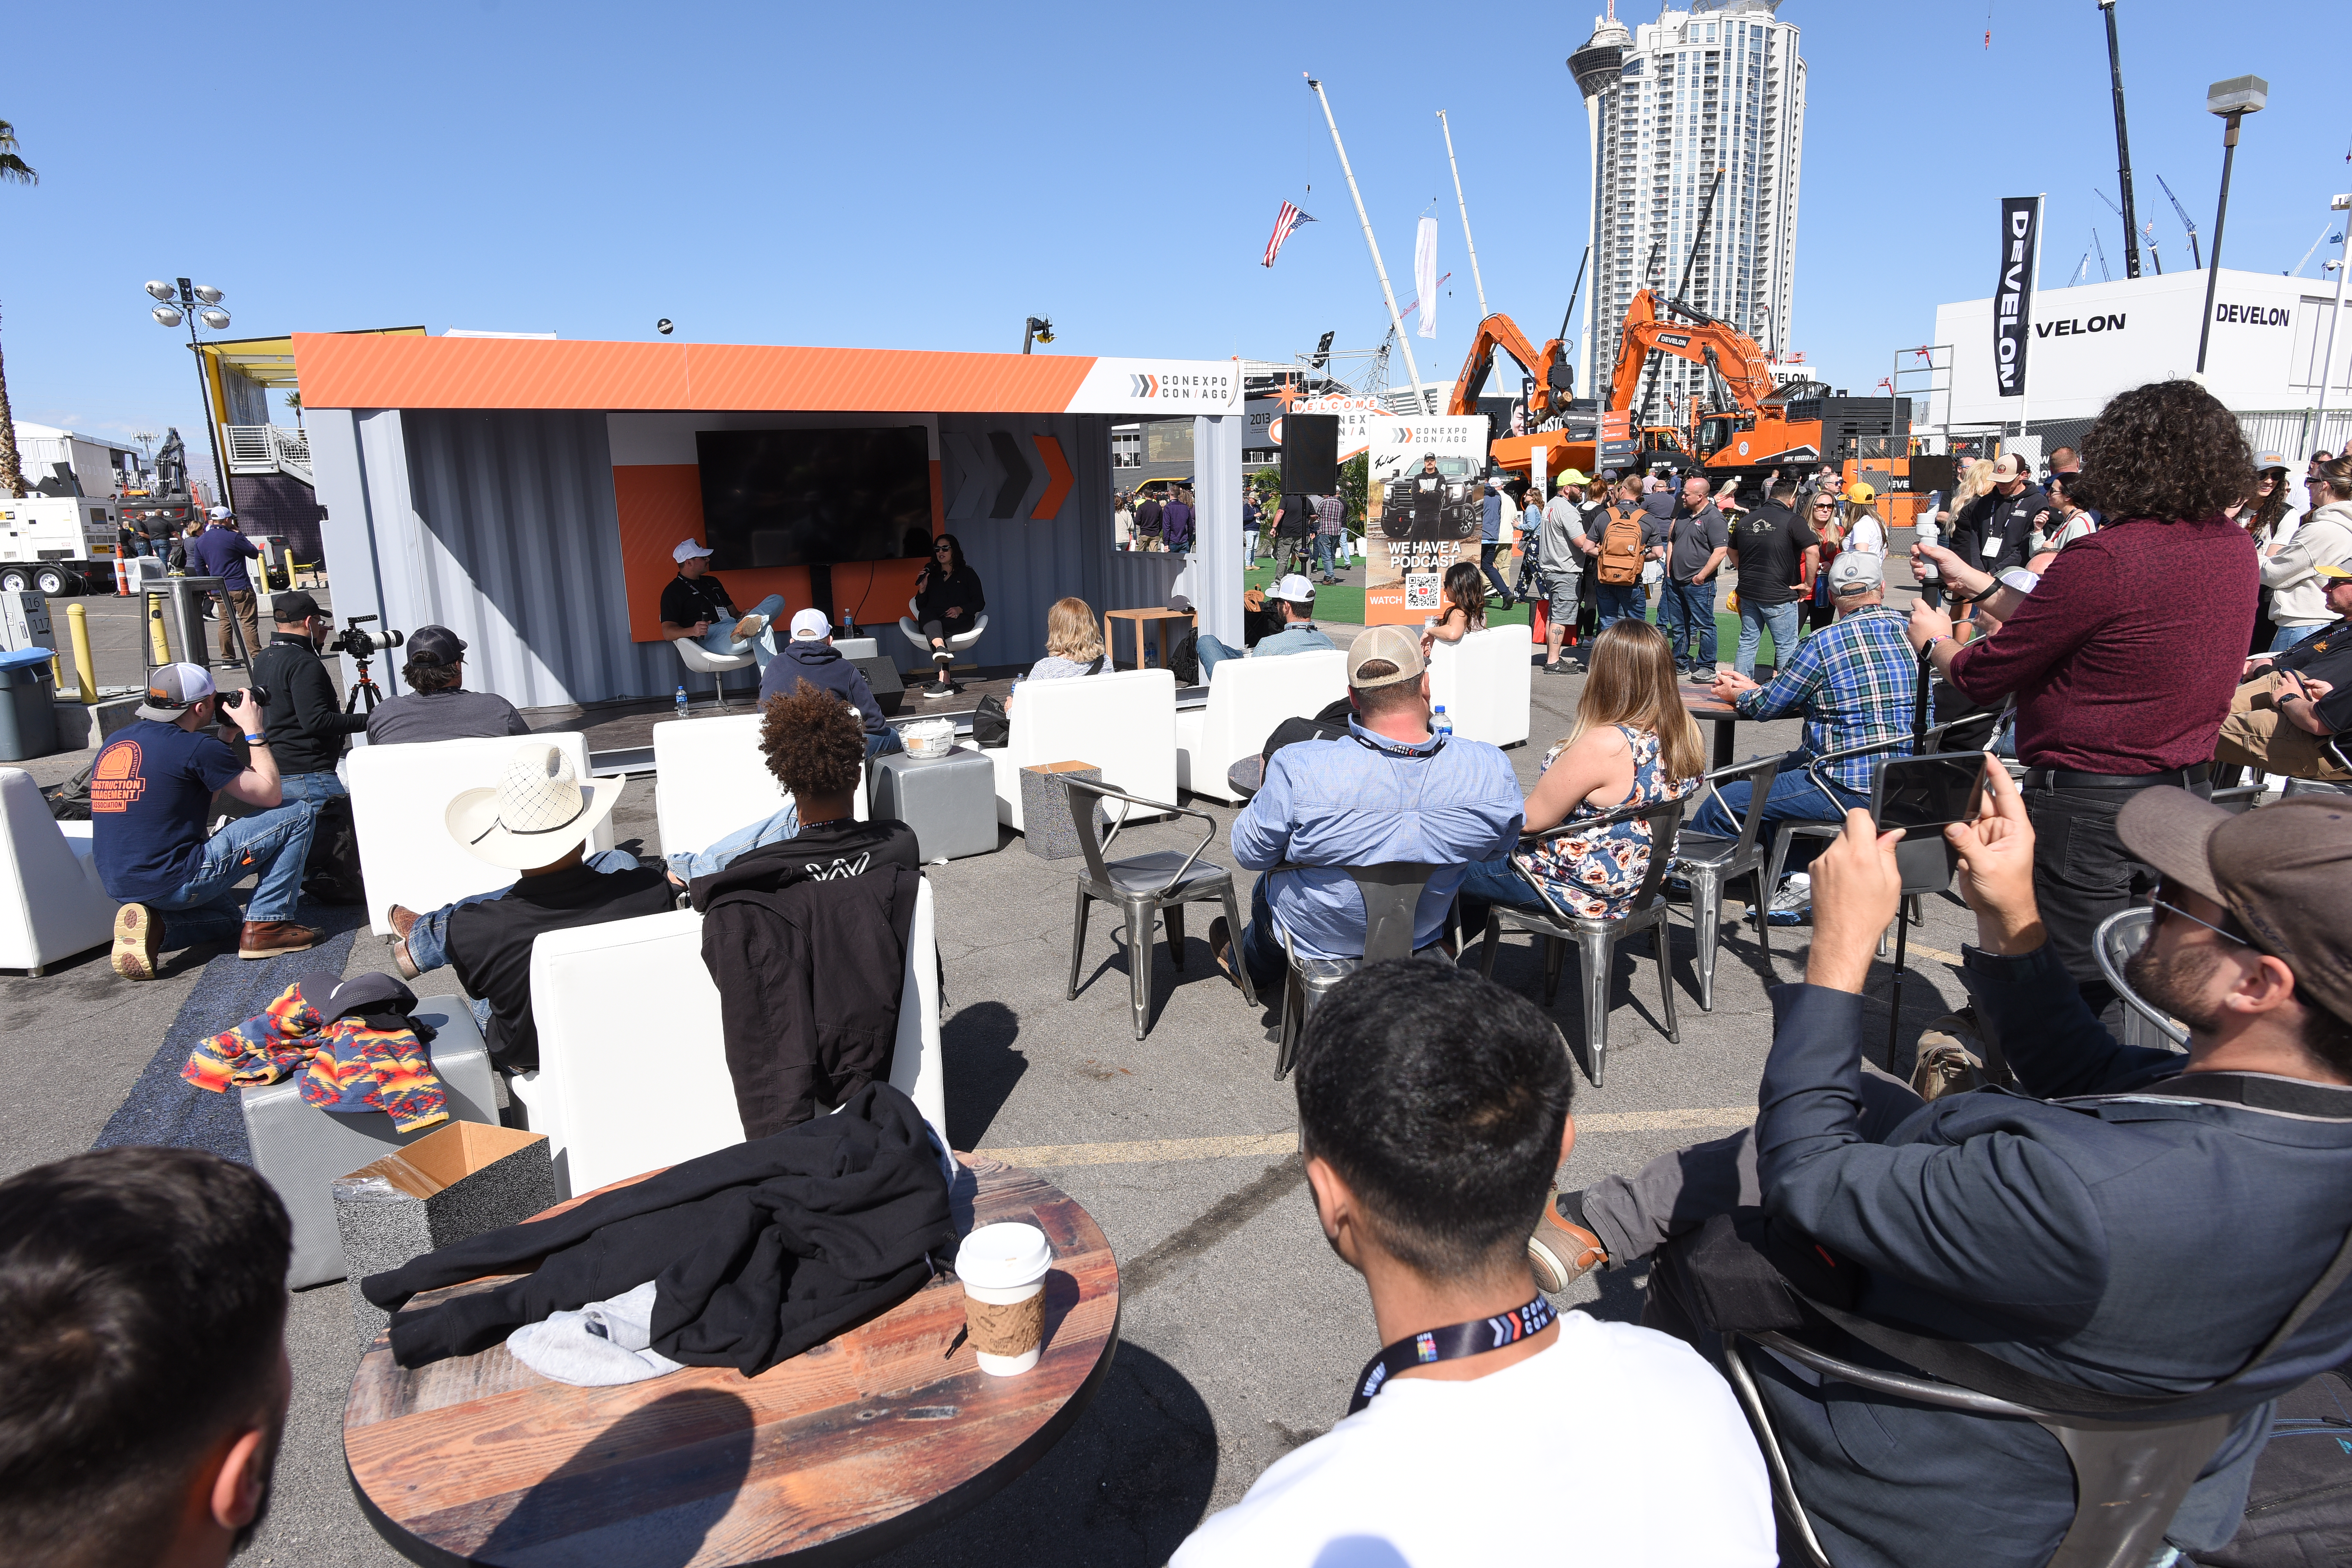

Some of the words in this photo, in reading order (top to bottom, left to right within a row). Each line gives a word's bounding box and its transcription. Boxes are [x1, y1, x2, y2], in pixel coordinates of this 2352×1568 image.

[1999, 211, 2029, 387] DEVELON
[2216, 303, 2290, 327] DEVELON
[2035, 313, 2126, 339] VELON
[1660, 335, 1686, 346] DEVELON
[1162, 375, 1227, 386] CONEXPO
[1769, 372, 1808, 383] VELON
[1162, 388, 1227, 399] CON/AGG
[1294, 400, 1375, 412] WELCOME
[1250, 412, 1271, 425] 2013
[1387, 542, 1410, 554] WE
[1412, 541, 1449, 553] HAVE
[1451, 541, 1461, 553] A
[1390, 555, 1458, 568] PODCAST
[21, 597, 40, 608] 116
[1369, 596, 1402, 605] WATCH
[33, 617, 49, 630] 117
[92, 780, 141, 790] CONSTRUCTION
